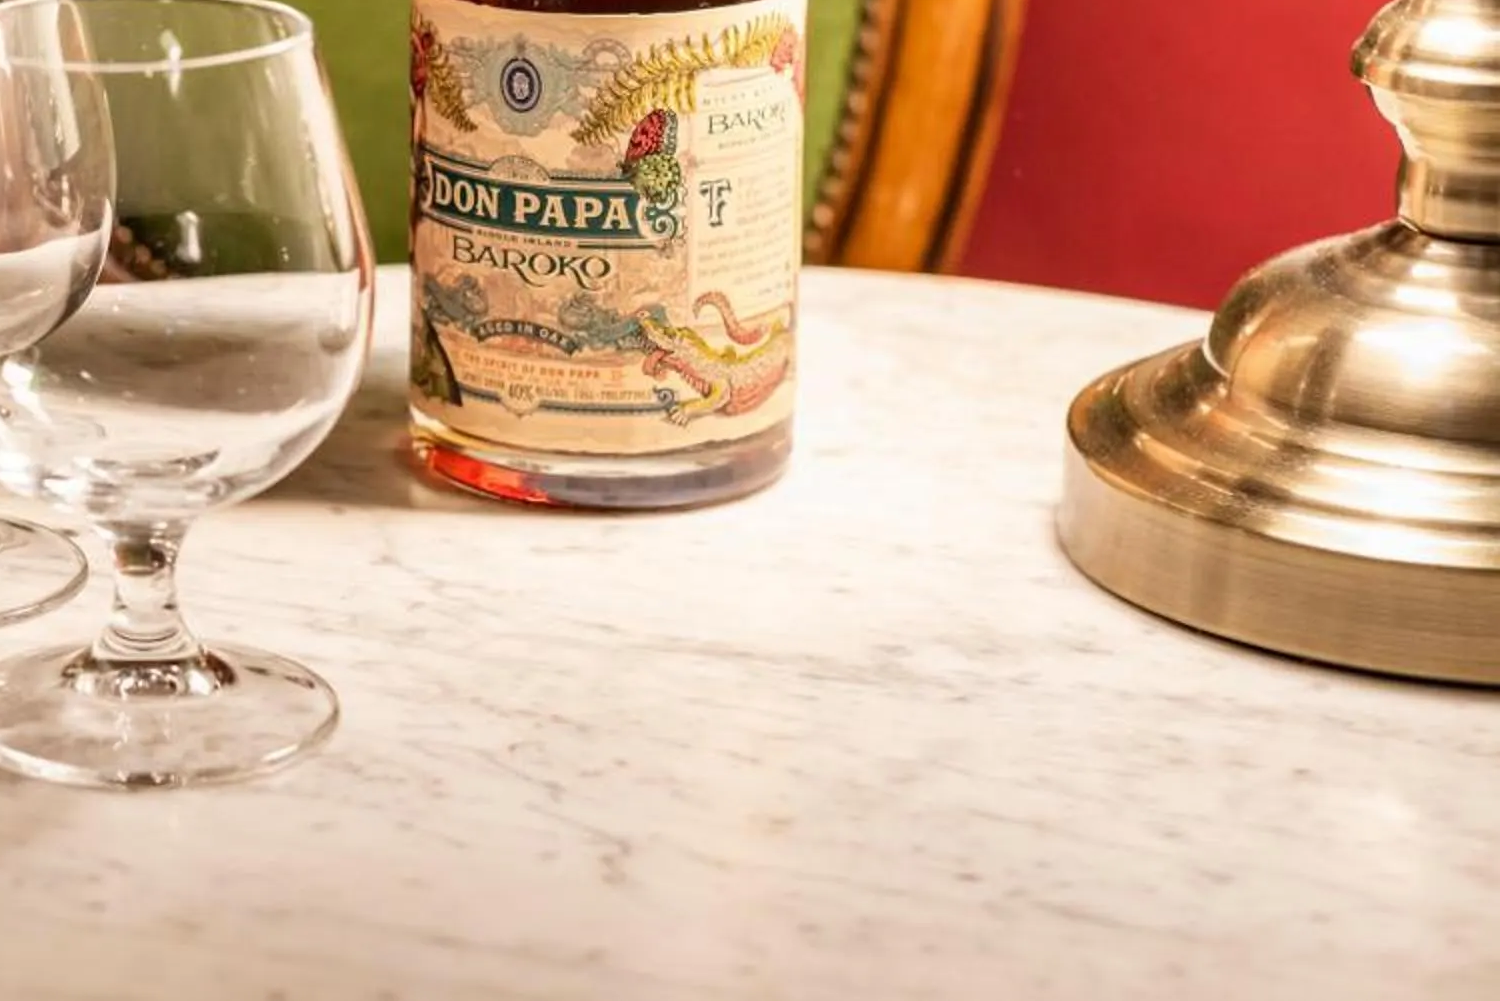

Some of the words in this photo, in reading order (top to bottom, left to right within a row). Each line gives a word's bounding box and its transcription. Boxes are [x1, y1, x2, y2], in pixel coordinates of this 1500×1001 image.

[435, 172, 500, 220] DON
[513, 190, 633, 231] PAPA
[452, 235, 611, 291] BAROKO
[517, 322, 534, 336] IN
[539, 328, 569, 348] OAK
